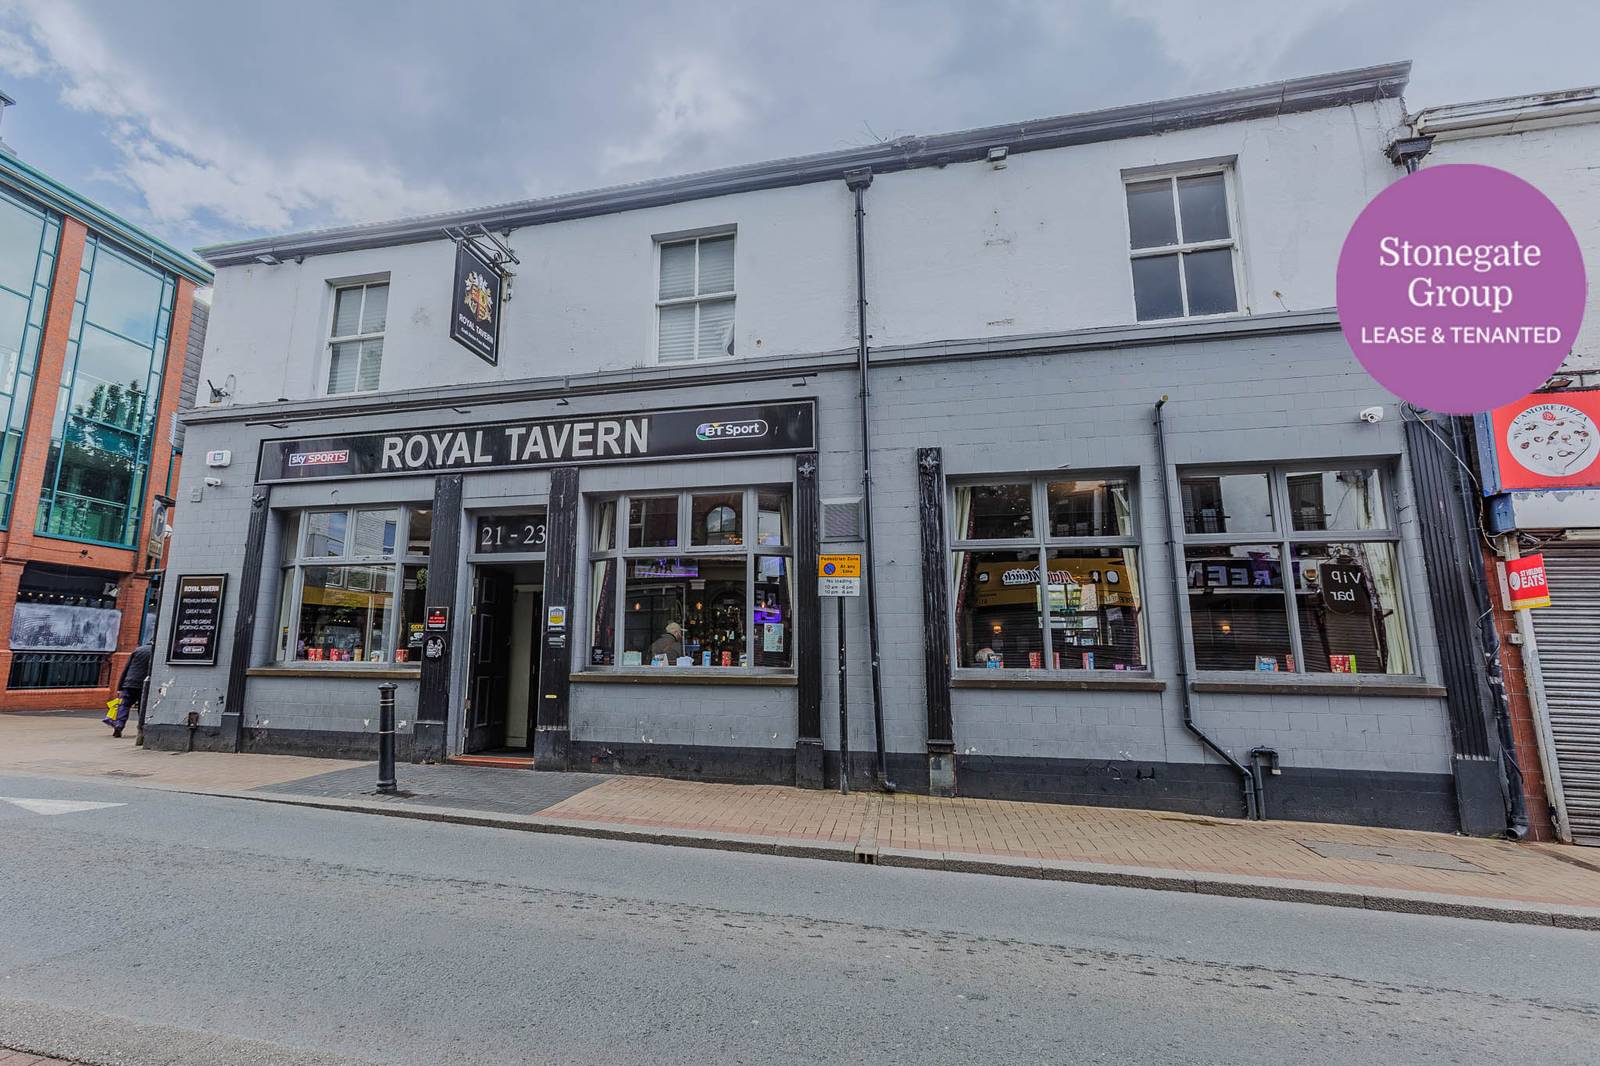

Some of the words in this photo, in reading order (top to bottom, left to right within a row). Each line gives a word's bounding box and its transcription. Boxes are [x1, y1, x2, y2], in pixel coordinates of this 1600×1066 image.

[705, 427, 724, 436] BT
[725, 422, 760, 436] Sport
[381, 430, 493, 470] ROYAL
[505, 418, 649, 461] TAVERN
[291, 455, 306, 464] sky
[308, 451, 346, 463] SPORTS
[481, 526, 503, 545] 21
[523, 524, 546, 544] 23
[1521, 574, 1545, 588] EATS
